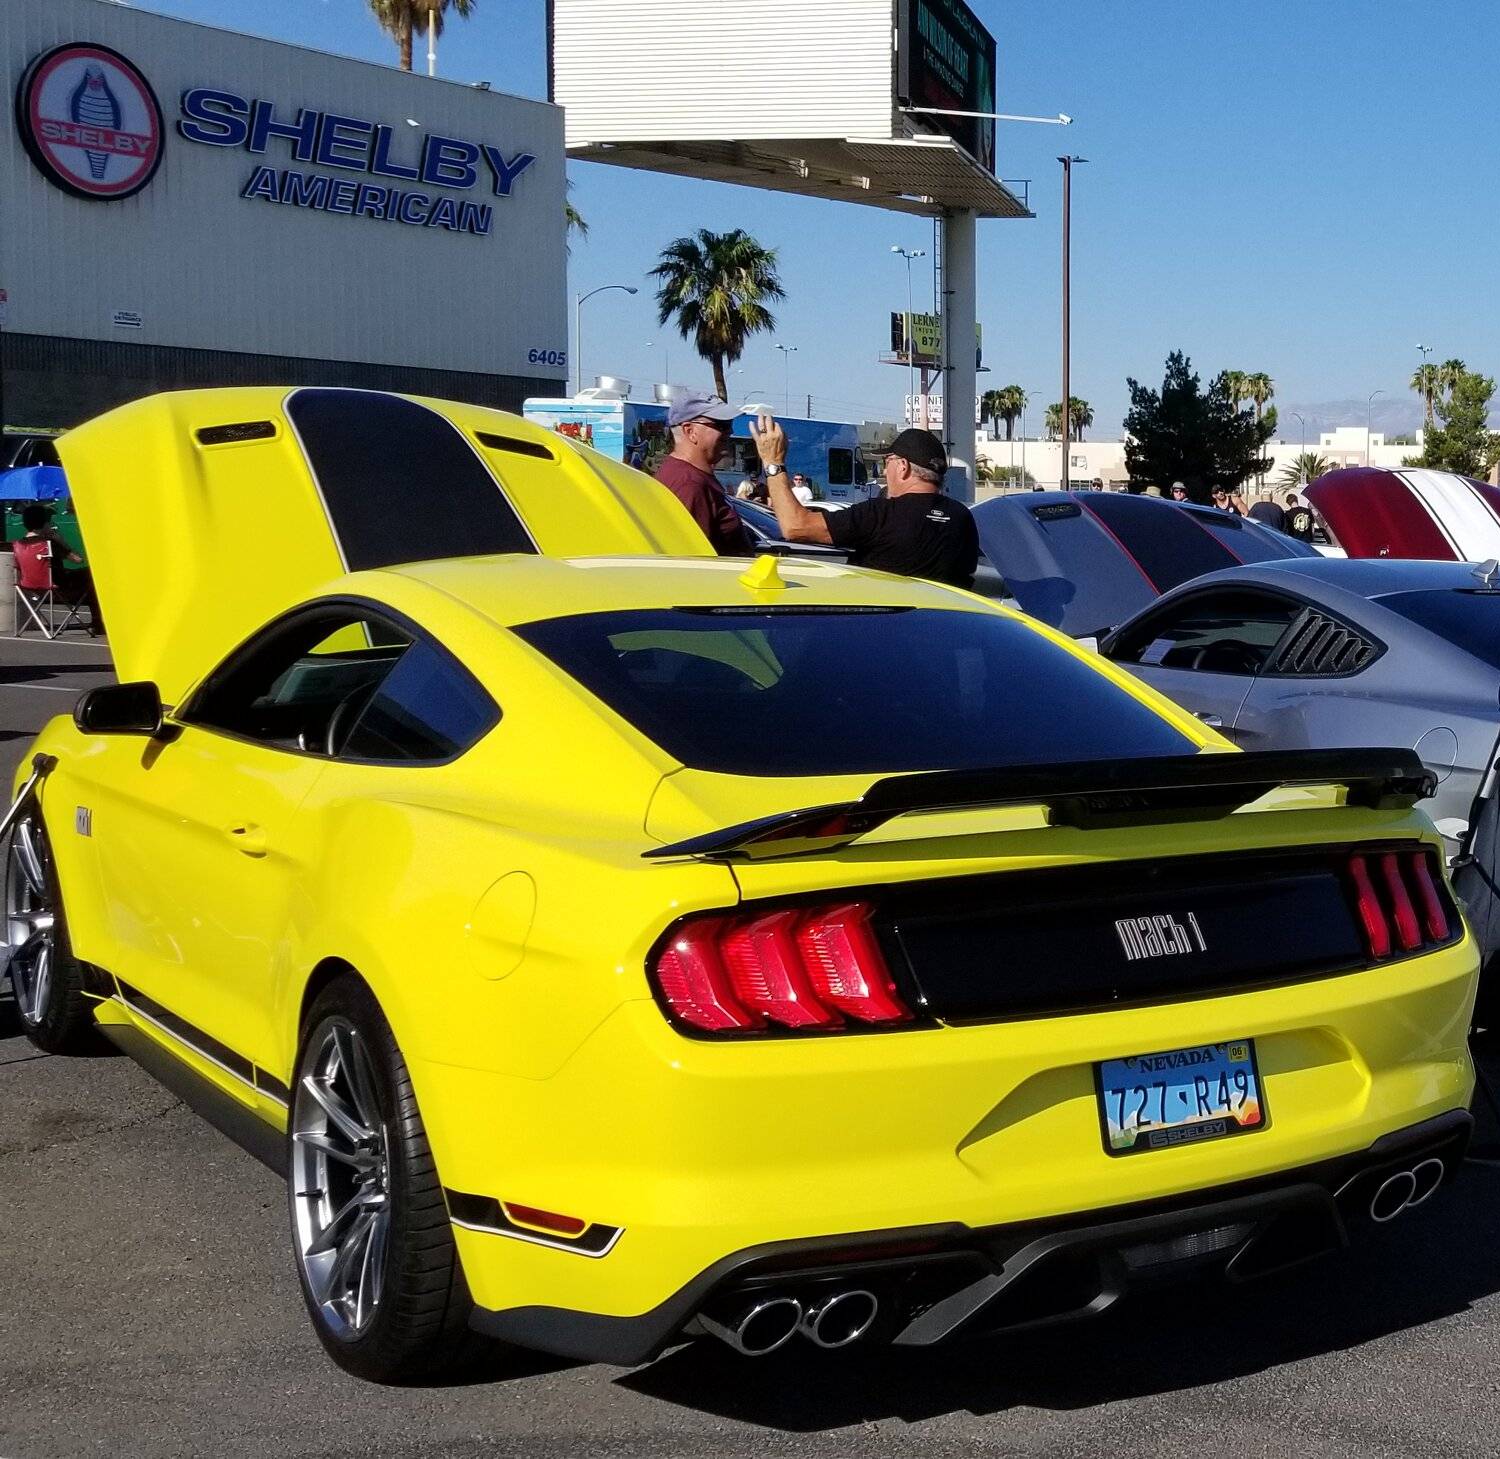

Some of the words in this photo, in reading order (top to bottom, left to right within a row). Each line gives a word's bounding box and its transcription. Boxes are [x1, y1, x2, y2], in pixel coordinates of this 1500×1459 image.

[41, 121, 150, 153] SHELBY
[178, 88, 537, 196] SHELBY
[241, 165, 493, 234] AMERICAN
[912, 313, 941, 328] LERNE
[528, 348, 566, 366] 6405
[1139, 1049, 1216, 1074] NEVADA
[1168, 1121, 1223, 1142] SHELBY
